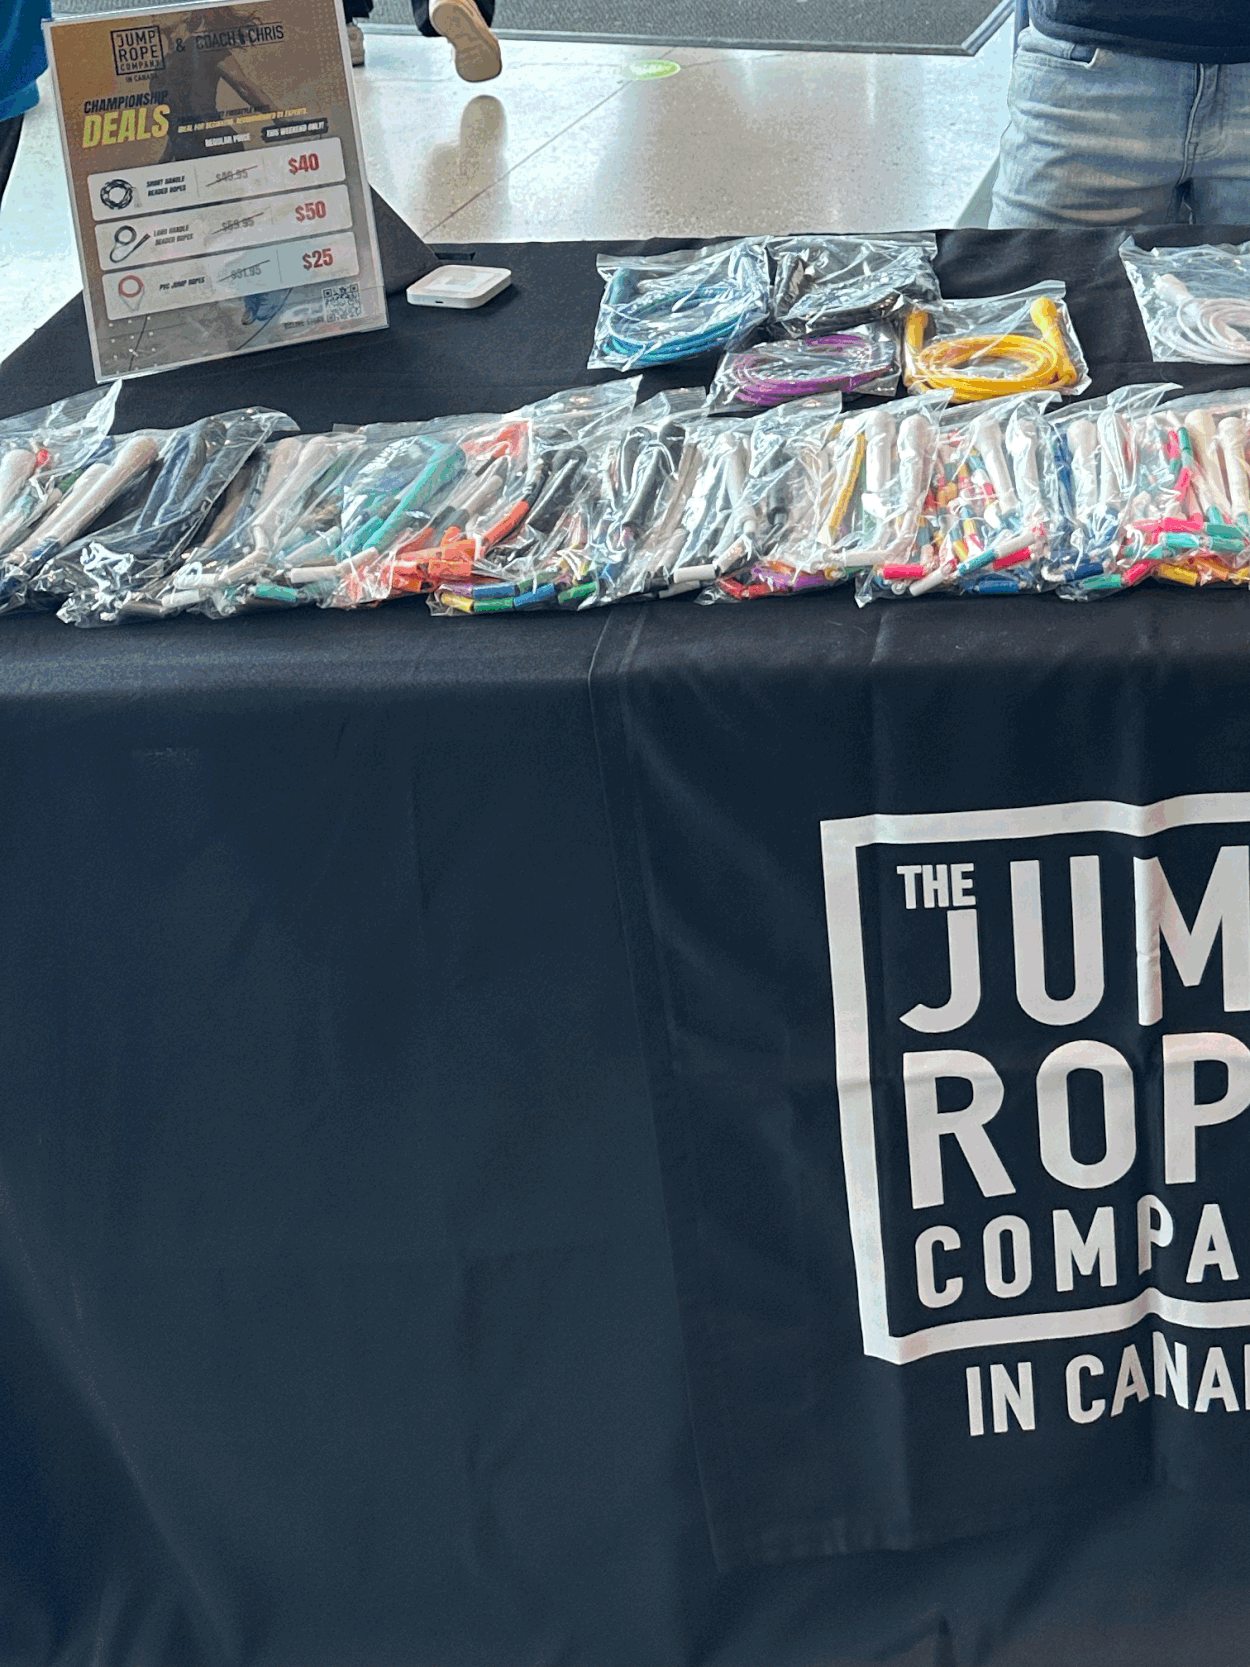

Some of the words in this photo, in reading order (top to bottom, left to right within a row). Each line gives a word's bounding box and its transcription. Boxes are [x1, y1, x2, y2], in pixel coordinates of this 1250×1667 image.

[116, 30, 156, 47] JUMP
[176, 37, 186, 52] &
[195, 31, 236, 50] COACH
[248, 25, 284, 43] CHRIS
[118, 44, 159, 62] ROPE
[120, 60, 161, 72] COMPANY
[84, 90, 169, 114] CHAMPIONSHIP
[82, 104, 170, 148] DEALS
[288, 153, 320, 175] $40
[295, 200, 326, 223] $50
[302, 248, 334, 271] $25
[896, 862, 976, 910] THE
[965, 1360, 1036, 1437] IN
